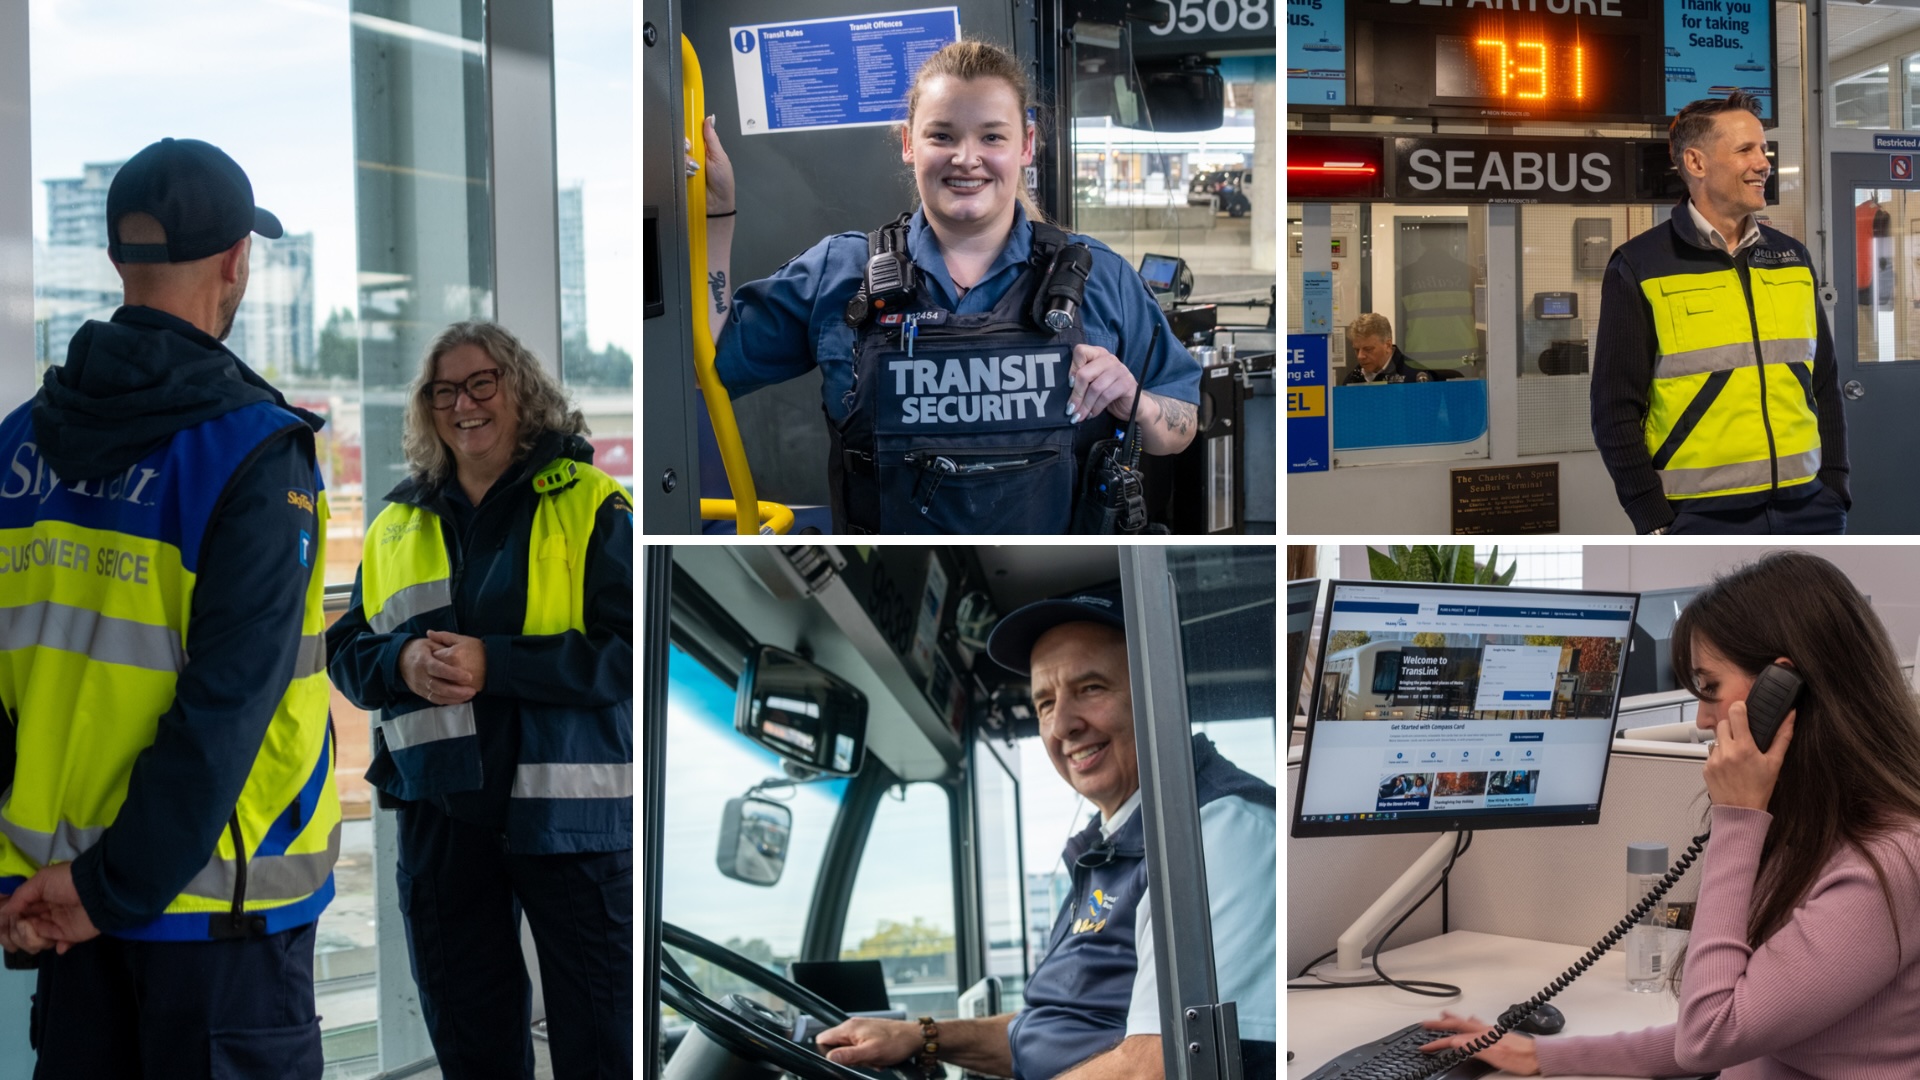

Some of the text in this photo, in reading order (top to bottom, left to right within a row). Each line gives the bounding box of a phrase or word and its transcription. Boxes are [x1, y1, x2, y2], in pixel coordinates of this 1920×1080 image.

[1726, 2, 1751, 16] you
[1287, 11, 1315, 26] us.
[1682, 14, 1750, 34] for taking
[850, 20, 903, 31] Transit Offences
[763, 29, 804, 40] Transit Rules
[1689, 33, 1743, 49] SeaBus.
[1477, 39, 1583, 98] 7:31
[1876, 138, 1916, 147] Restricted
[1408, 148, 1612, 192] SEABUS
[889, 353, 1061, 395] TRANSIT
[1304, 370, 1315, 378] at
[901, 390, 1051, 424] SECURITY
[1456, 476, 1472, 484] The
[1478, 473, 1510, 482] Charles
[1470, 481, 1542, 493] SeaBus Terminal
[1403, 655, 1448, 665] Welcome to
[1402, 666, 1438, 676] TransLink
